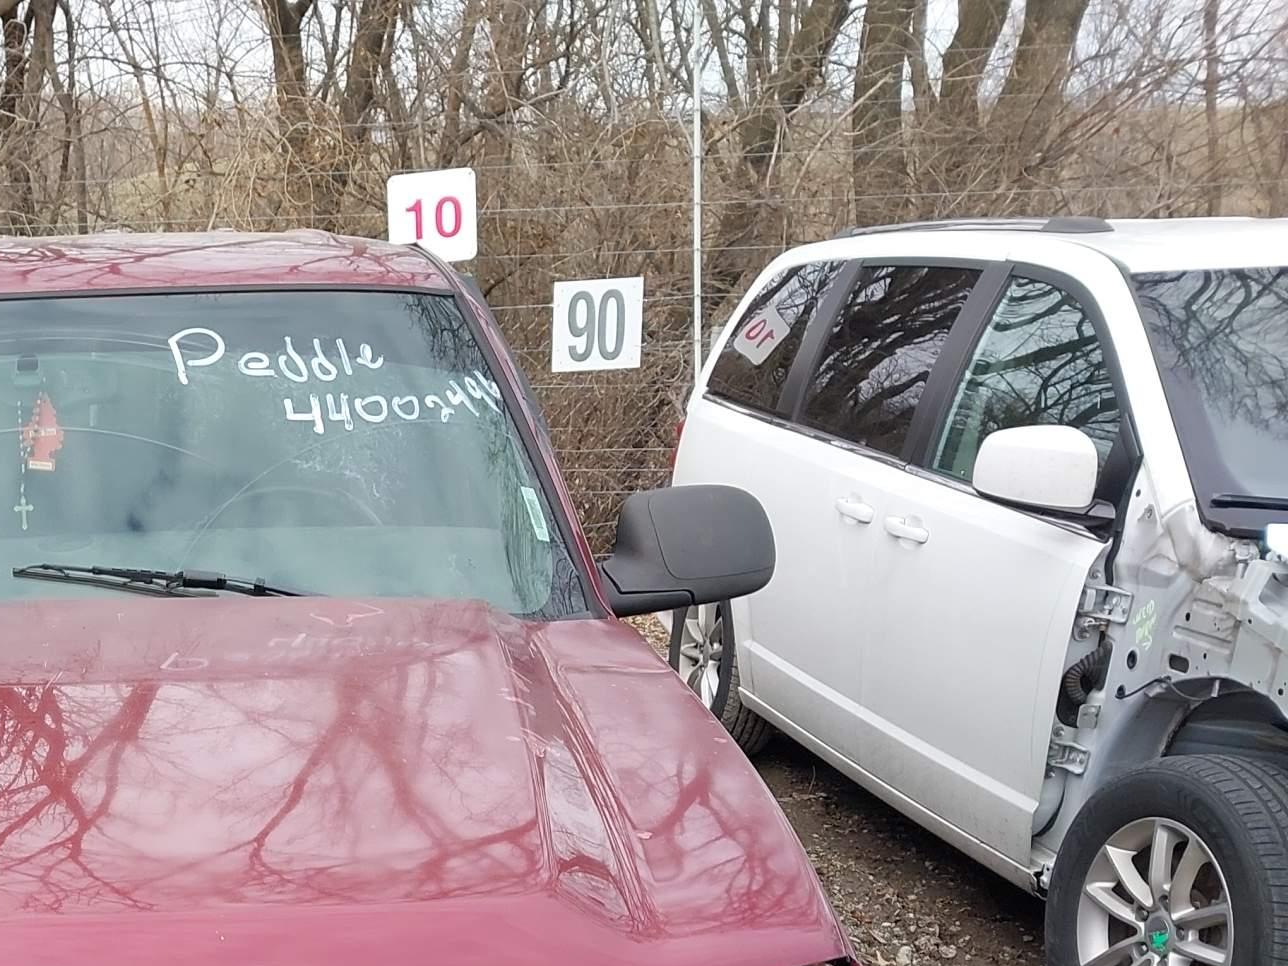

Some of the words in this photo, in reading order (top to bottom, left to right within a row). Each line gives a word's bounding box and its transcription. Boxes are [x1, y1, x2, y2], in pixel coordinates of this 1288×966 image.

[405, 195, 463, 240] 10
[567, 288, 626, 363] 90
[167, 327, 385, 386] Peddle
